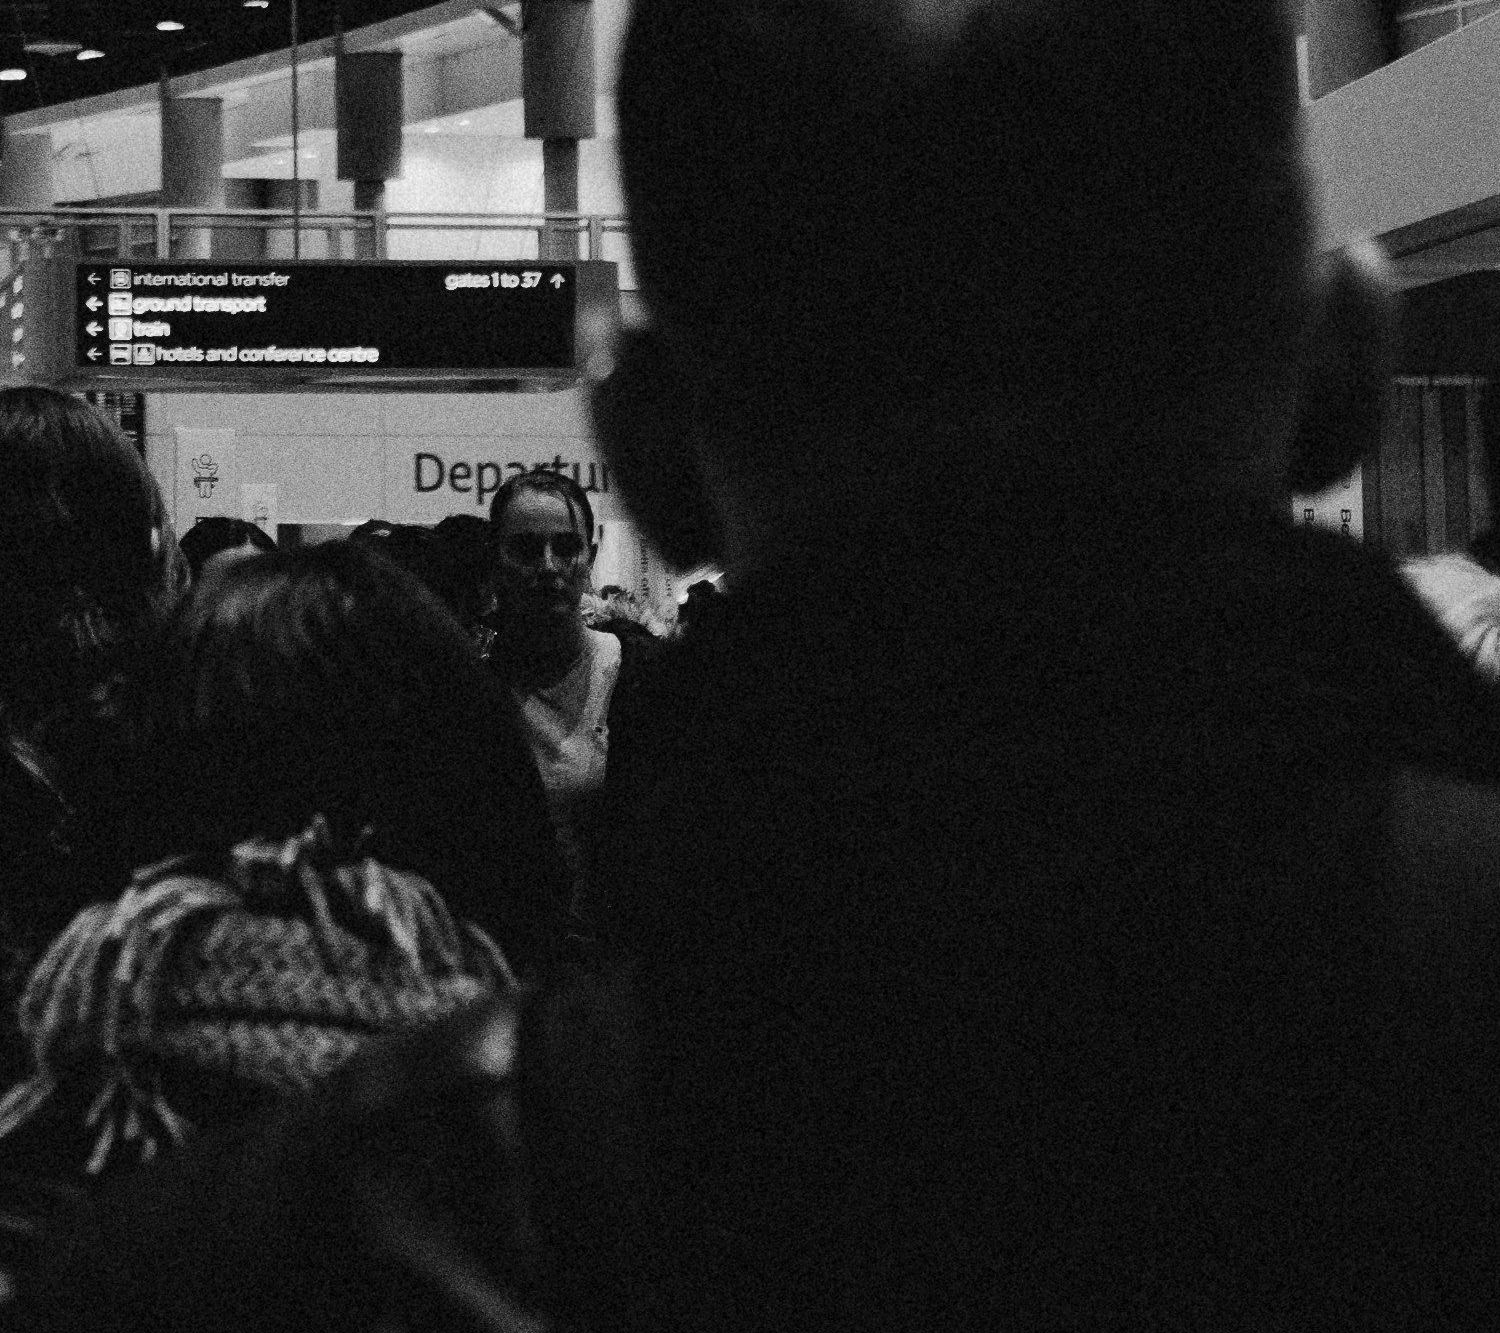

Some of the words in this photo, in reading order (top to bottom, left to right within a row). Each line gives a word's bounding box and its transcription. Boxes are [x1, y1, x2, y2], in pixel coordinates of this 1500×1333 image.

[133, 272, 228, 286] international
[231, 272, 290, 287] transfer
[444, 273, 491, 291] gates
[490, 272, 500, 288] 1
[500, 273, 520, 288] to
[520, 271, 542, 288] 37
[132, 295, 193, 315] ground
[192, 295, 267, 315] transport
[132, 320, 171, 337] train
[155, 346, 205, 362] hotels
[205, 346, 238, 362] and
[238, 344, 327, 362] conference
[326, 346, 380, 363] centre
